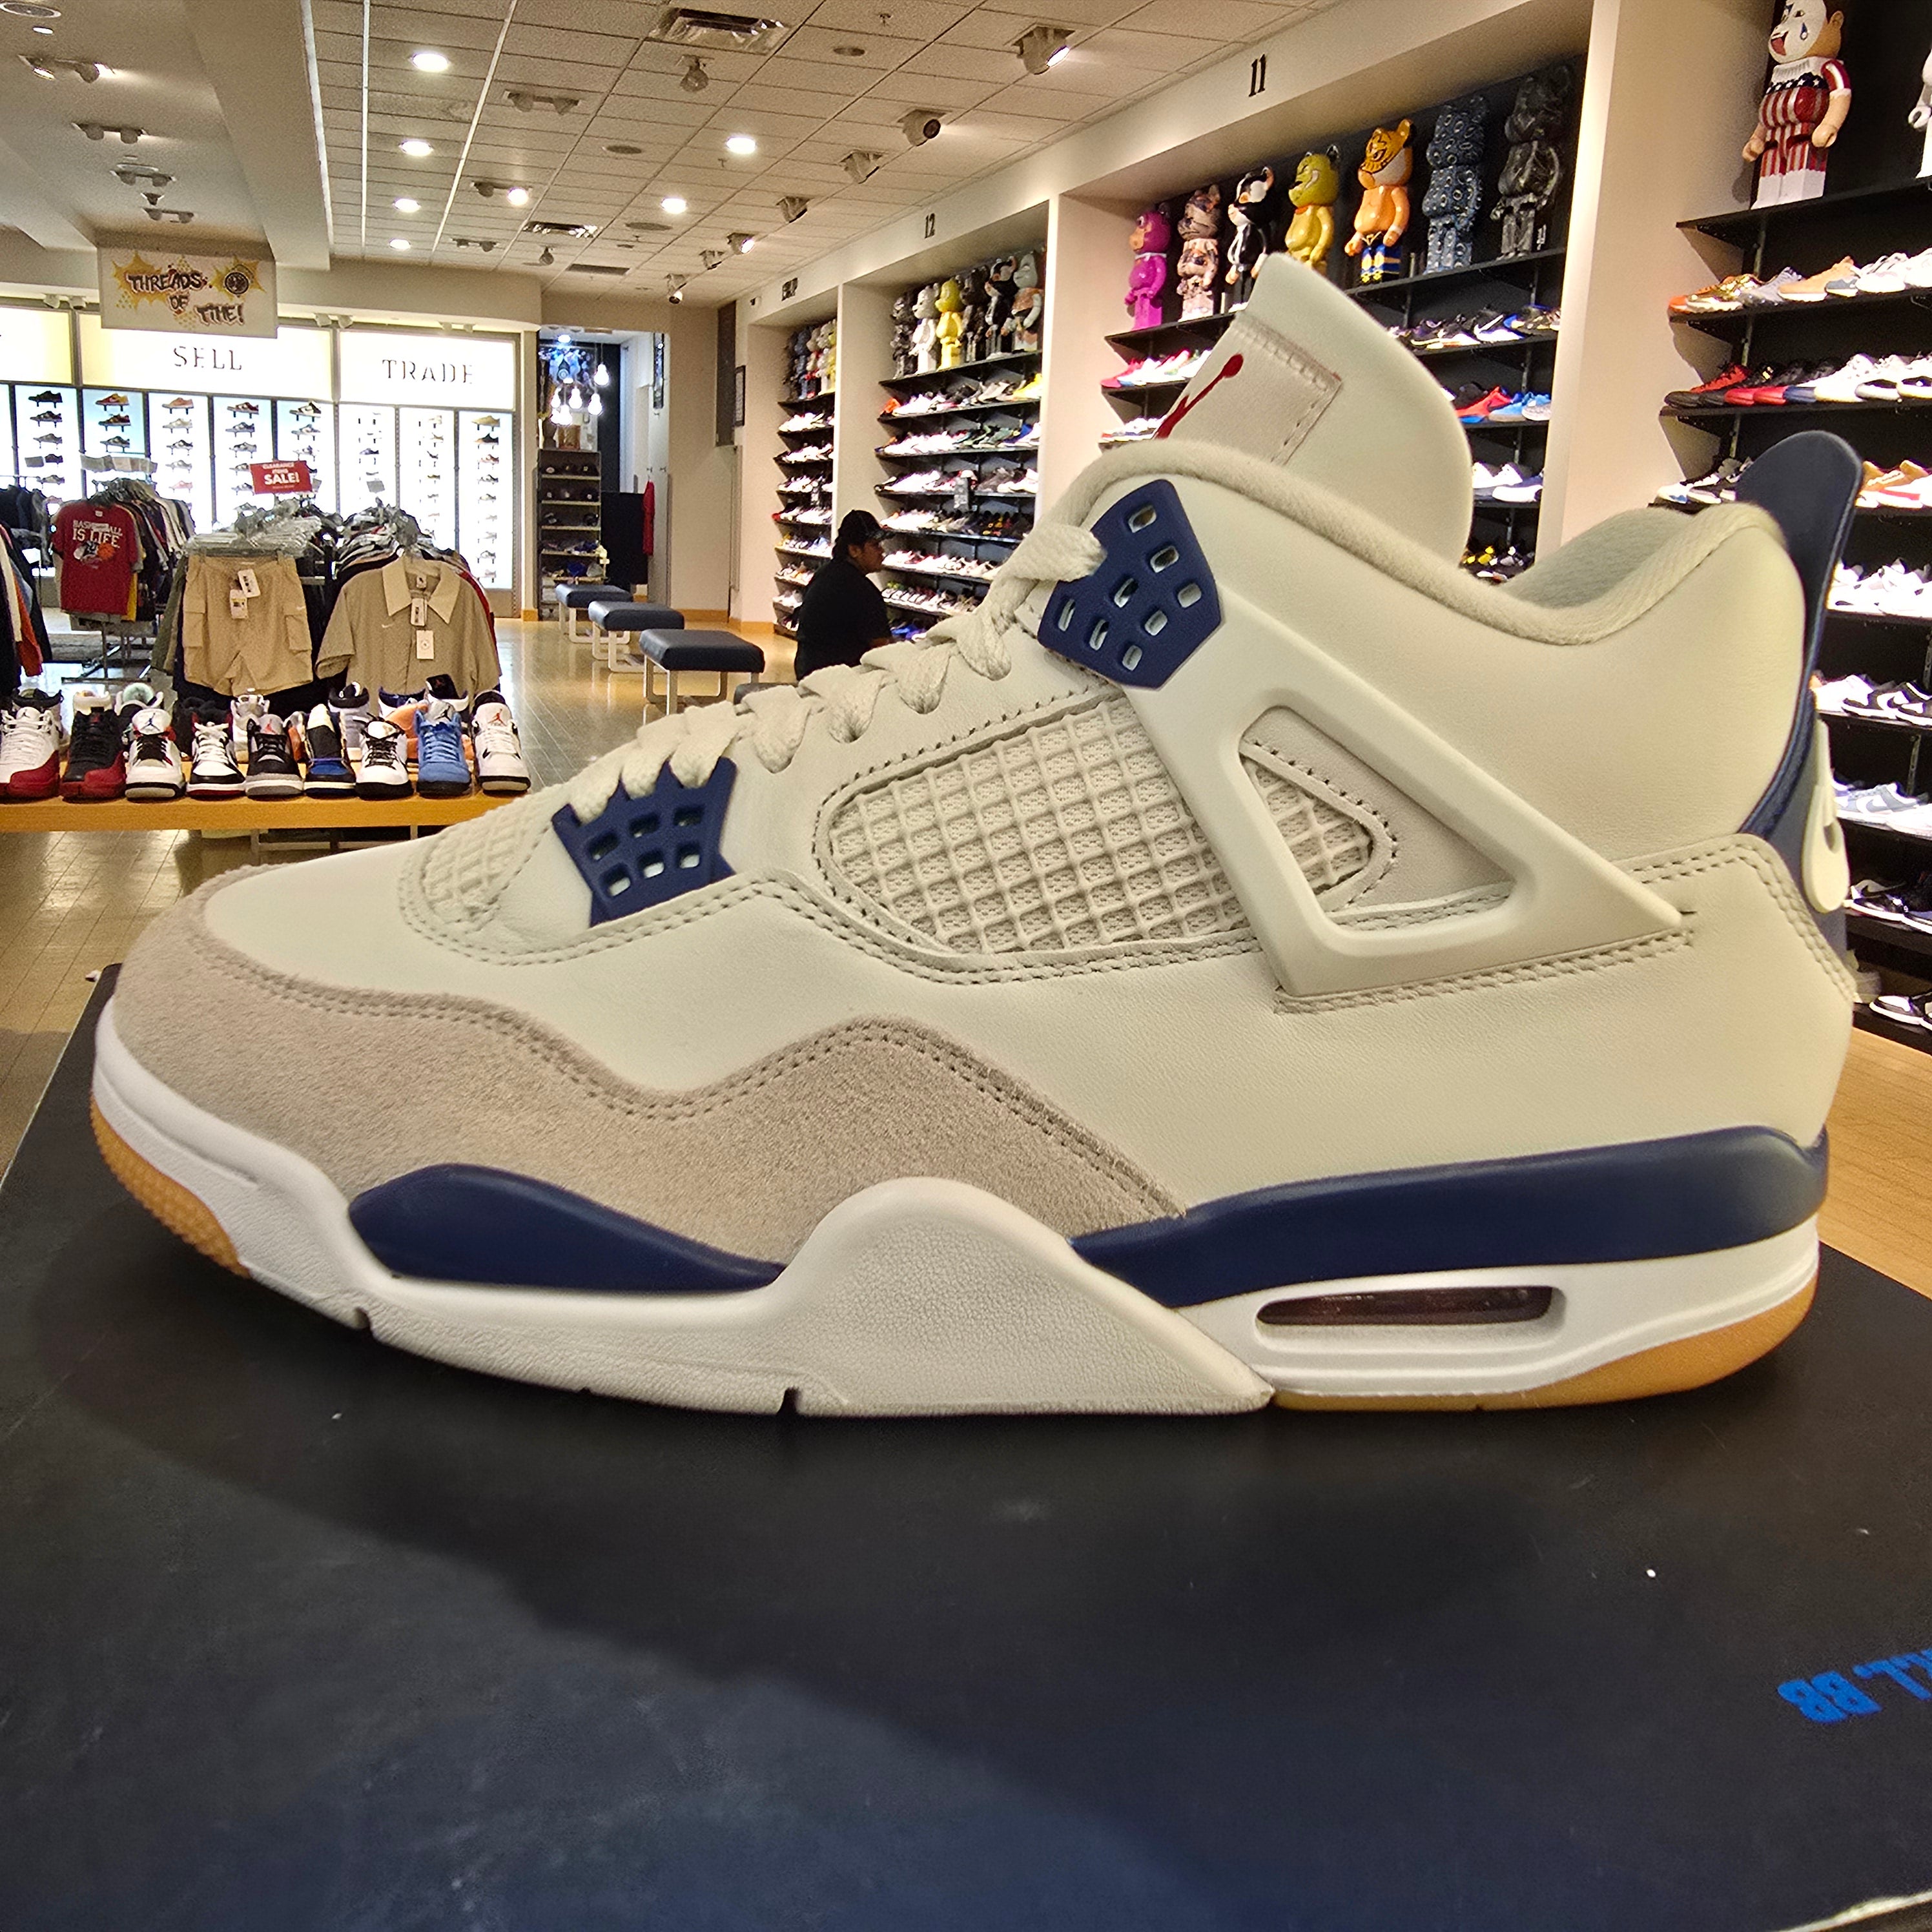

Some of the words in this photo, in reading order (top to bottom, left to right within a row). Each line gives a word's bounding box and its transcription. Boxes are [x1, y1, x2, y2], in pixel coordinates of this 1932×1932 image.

[1248, 54, 1266, 97] 11
[924, 213, 935, 239] 12
[128, 270, 203, 292] THREADS
[169, 294, 189, 311] OF
[173, 345, 242, 371] SELL
[382, 359, 473, 385] TRADE
[72, 528, 87, 542] IS
